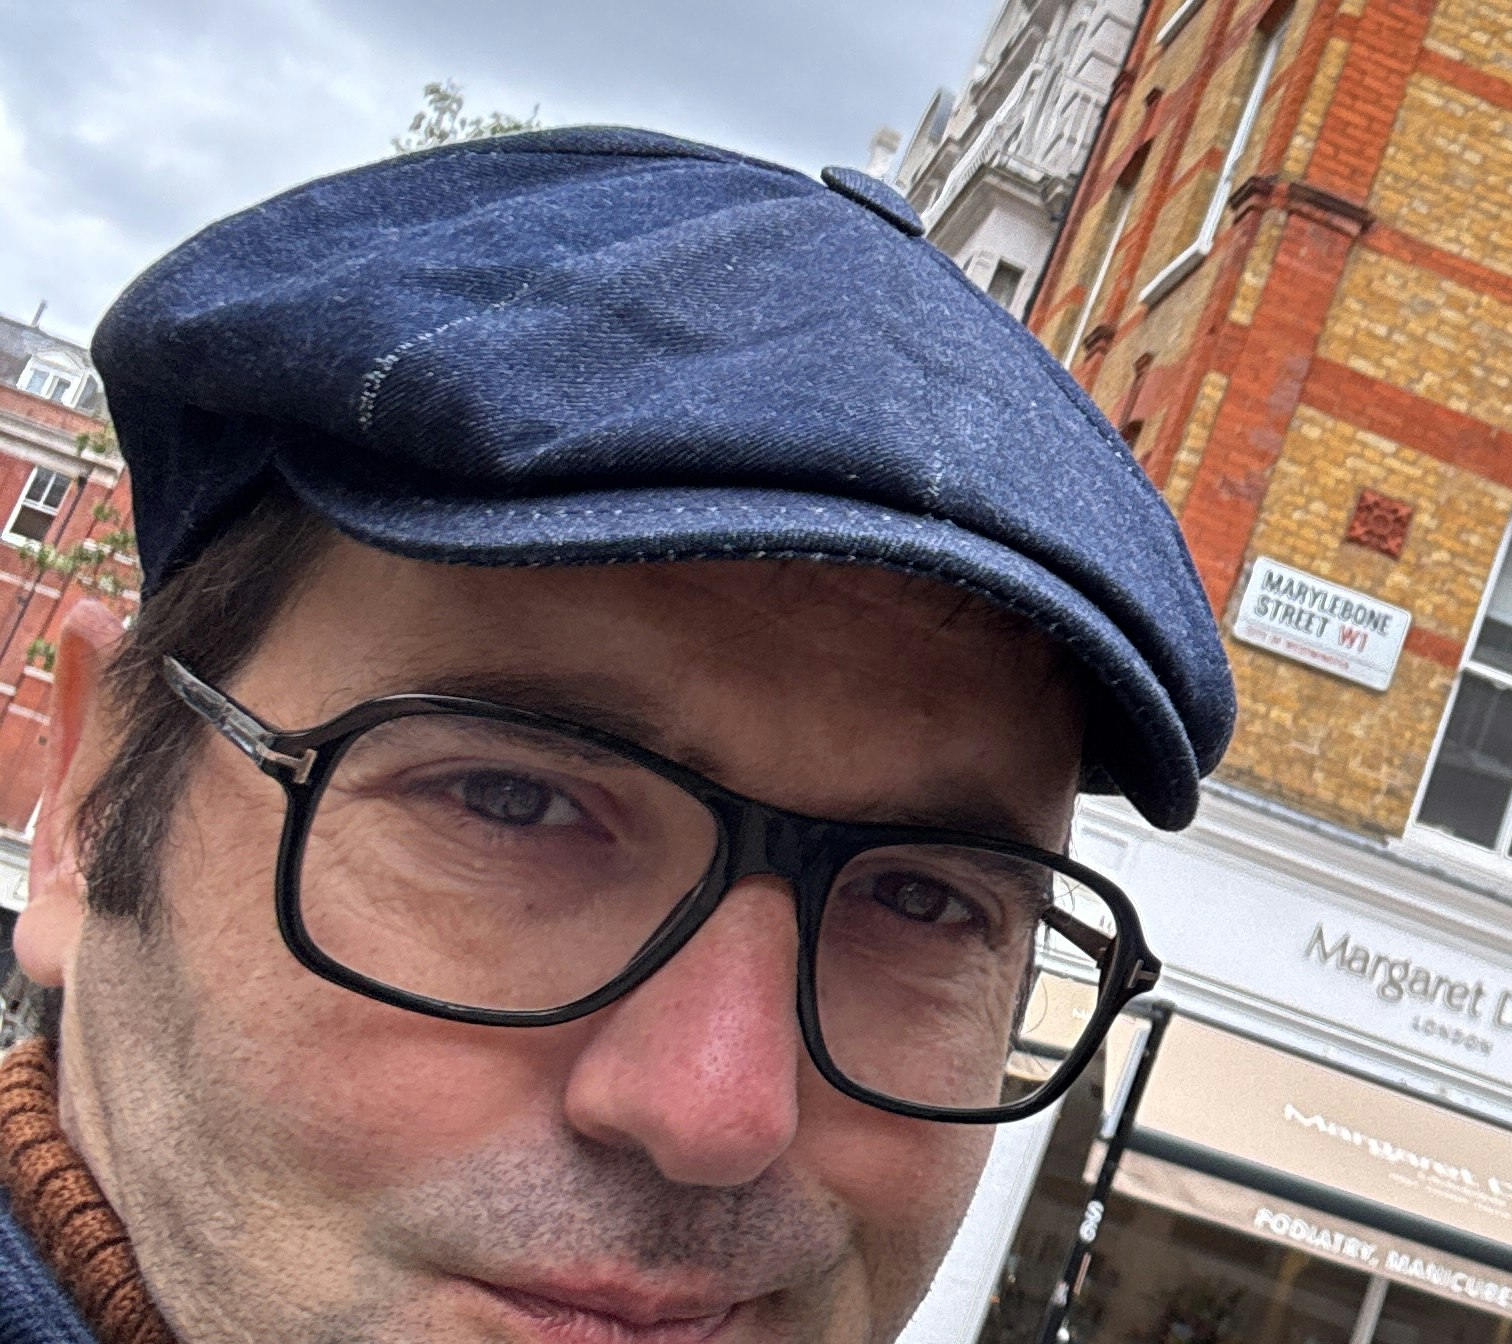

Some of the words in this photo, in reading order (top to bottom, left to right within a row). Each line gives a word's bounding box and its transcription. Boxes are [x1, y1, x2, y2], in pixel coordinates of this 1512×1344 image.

[1254, 594, 1330, 638] STREET
[1338, 624, 1369, 652] W1
[1263, 570, 1394, 637] MARYLEBONE
[1304, 921, 1485, 1018] Margaret
[1411, 1015, 1494, 1055] LONDON
[1254, 1207, 1380, 1268] PODIATRY,
